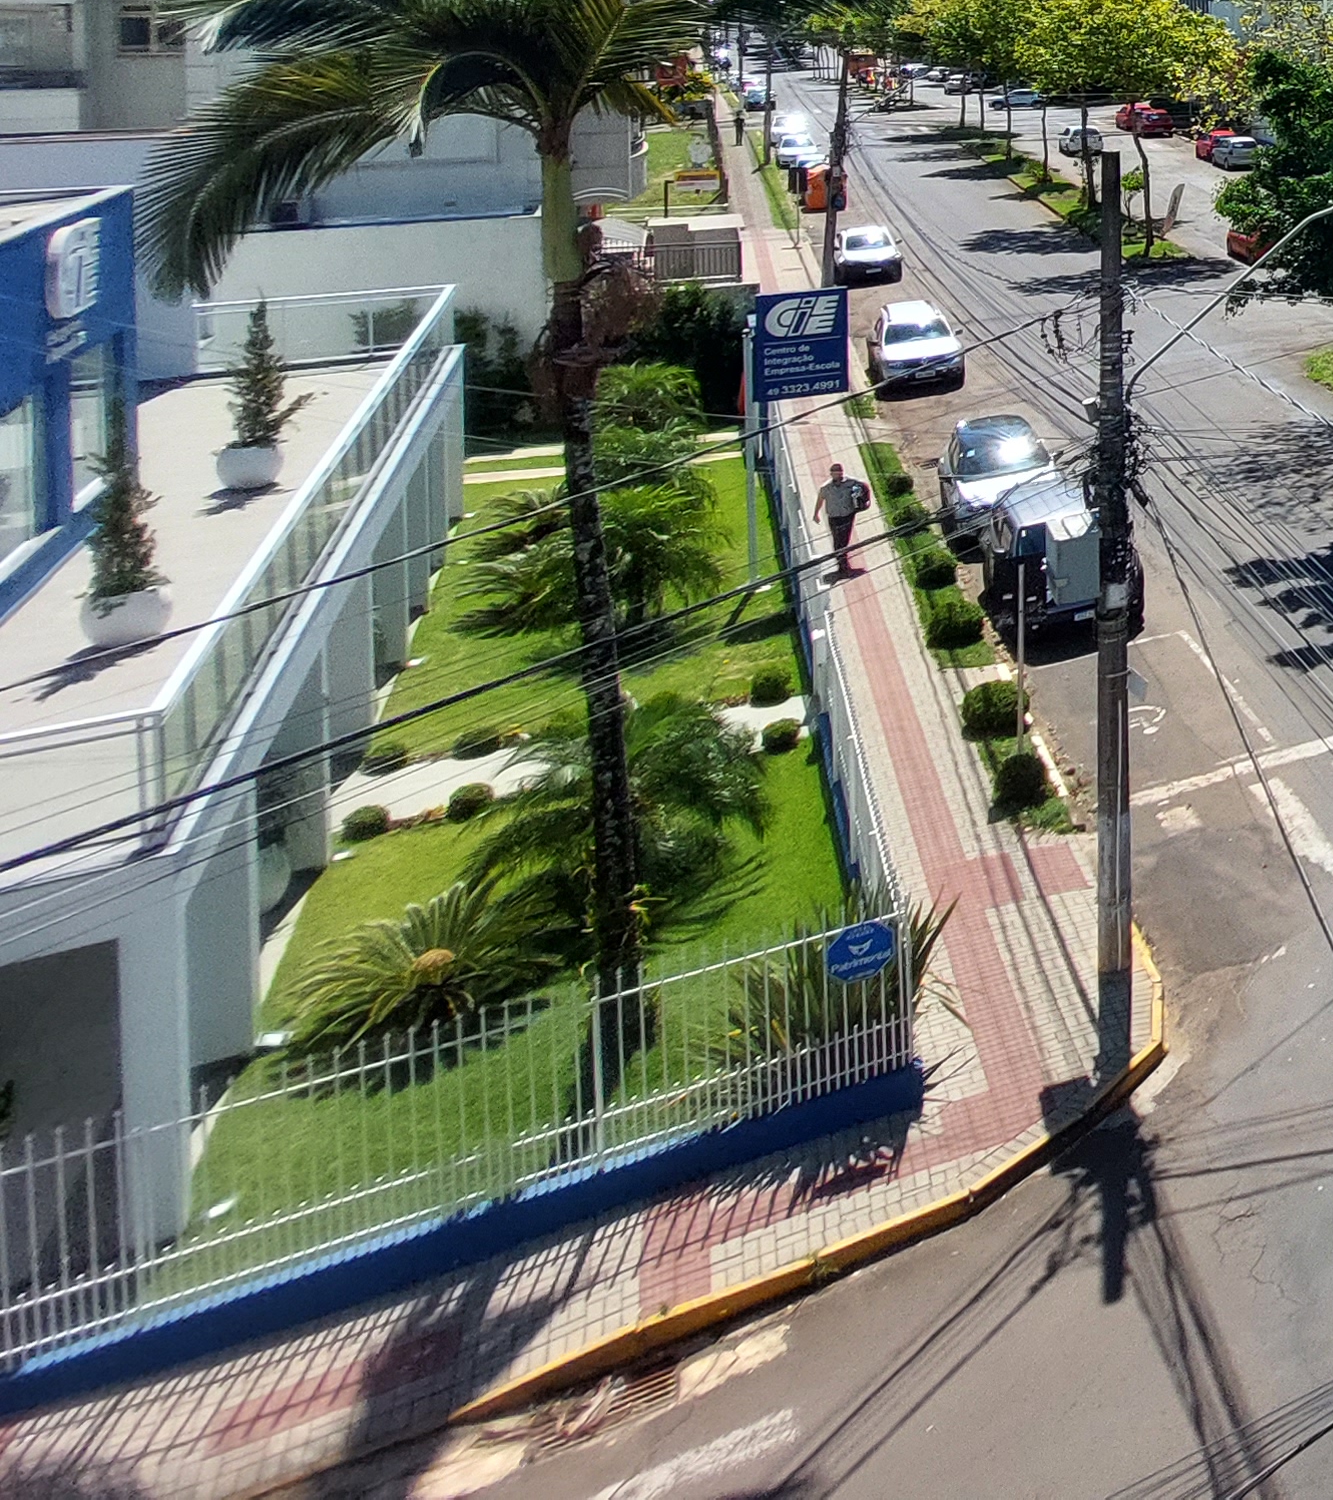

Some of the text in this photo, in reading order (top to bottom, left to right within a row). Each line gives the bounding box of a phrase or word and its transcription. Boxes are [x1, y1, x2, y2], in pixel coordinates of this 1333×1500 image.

[764, 344, 810, 356] Centro de
[764, 354, 814, 366] Integração
[764, 361, 841, 377] Empresa-Escola
[766, 387, 780, 396] 49
